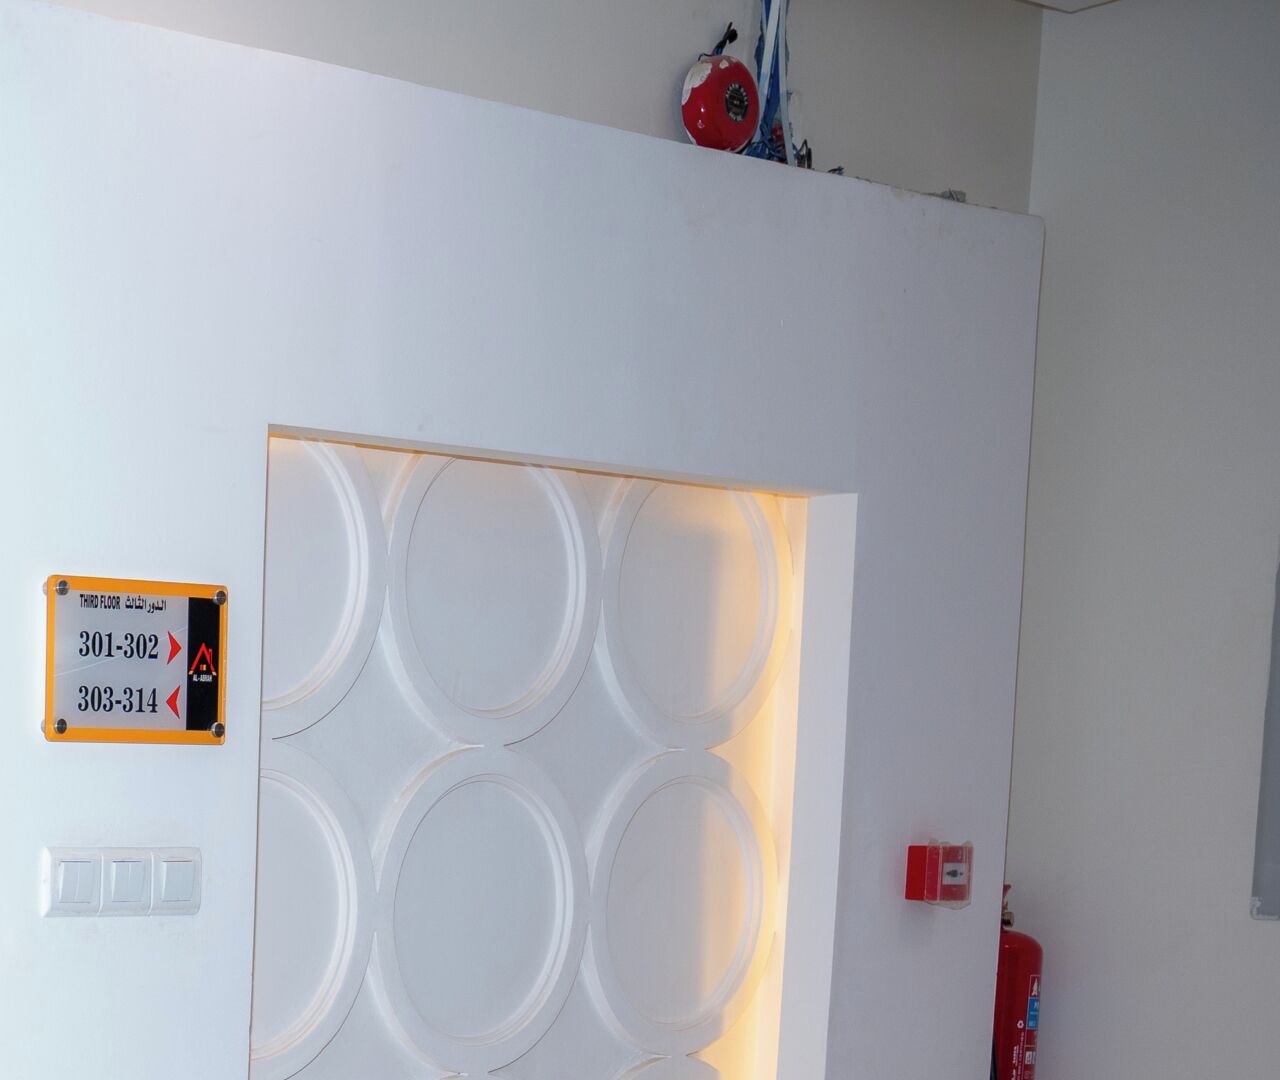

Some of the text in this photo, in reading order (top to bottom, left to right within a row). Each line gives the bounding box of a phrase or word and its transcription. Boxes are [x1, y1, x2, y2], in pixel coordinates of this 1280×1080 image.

[80, 594, 120, 609] THIRD FLOOR
[125, 595, 167, 613] الدور الثالث
[79, 630, 159, 659] 301-302
[78, 685, 158, 713] 303-314
